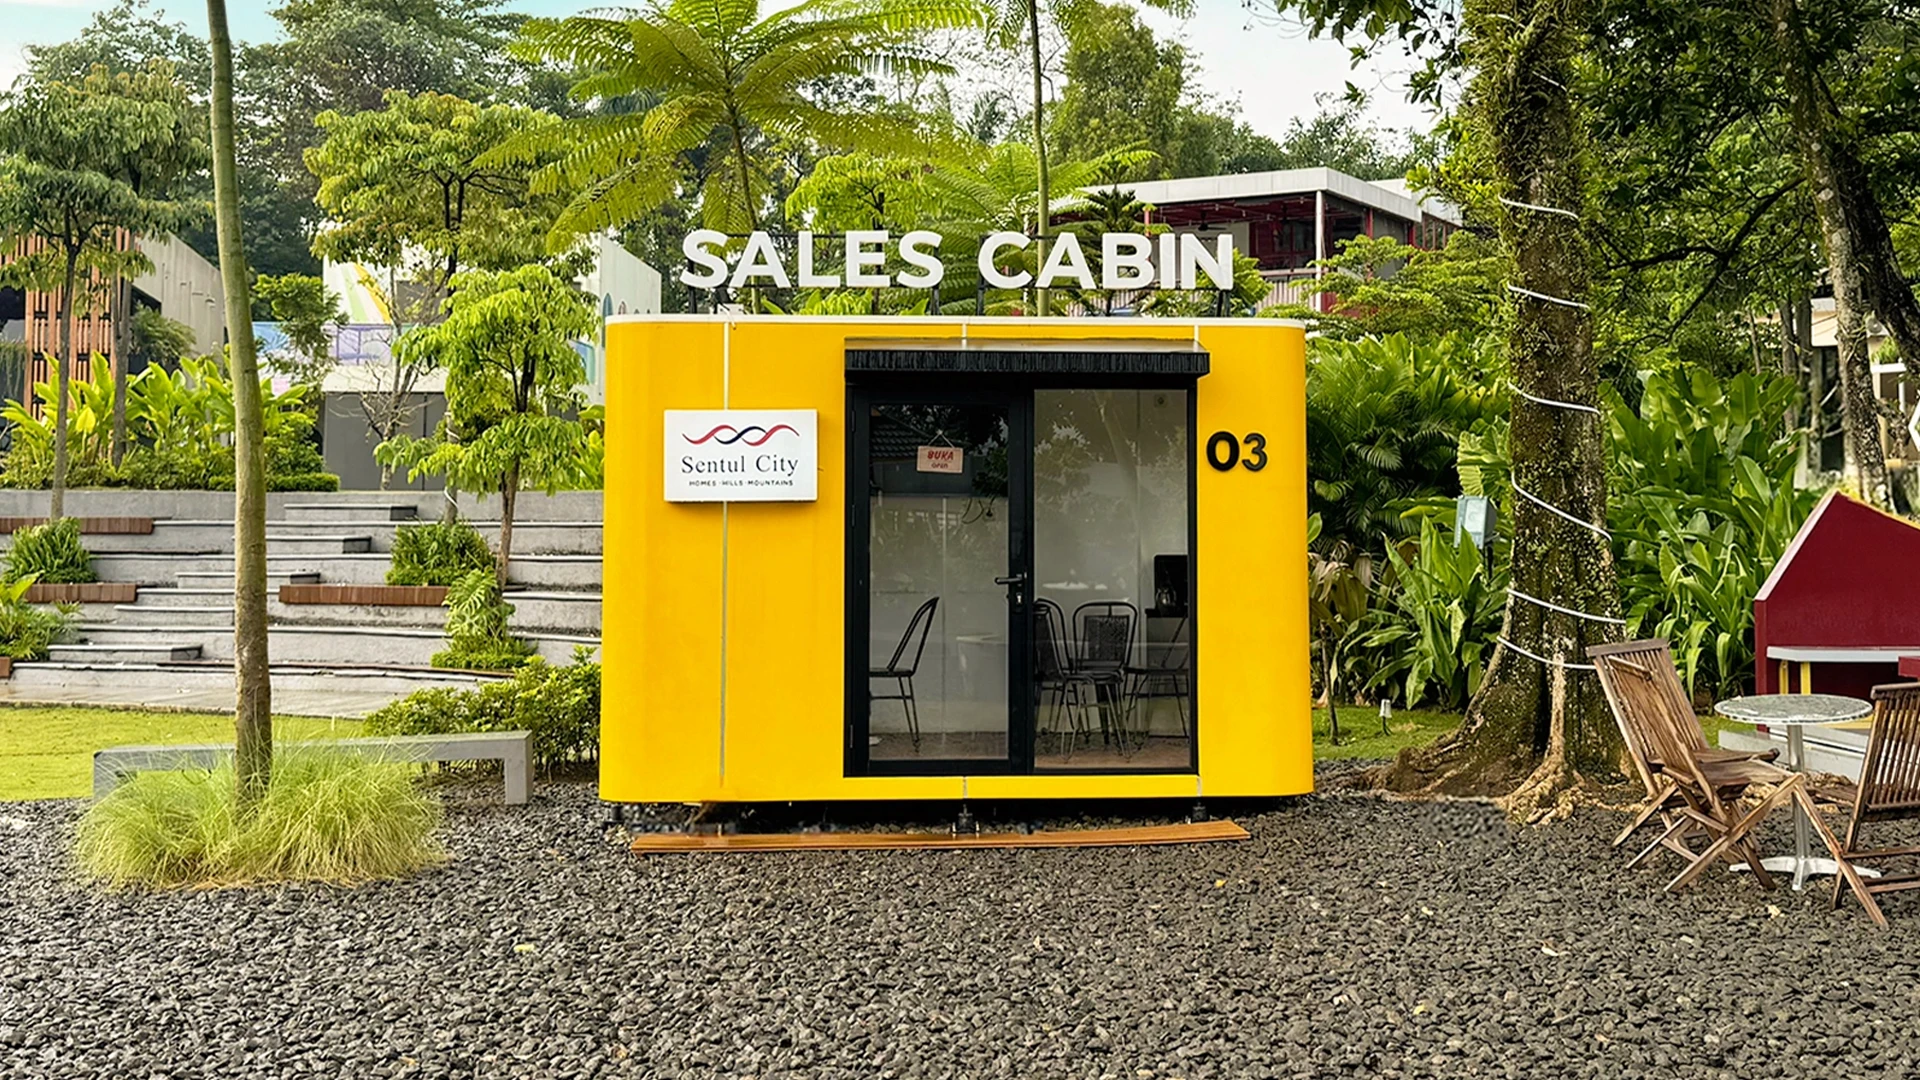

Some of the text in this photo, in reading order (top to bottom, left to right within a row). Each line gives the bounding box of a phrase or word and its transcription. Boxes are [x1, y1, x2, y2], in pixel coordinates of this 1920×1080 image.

[679, 229, 1234, 290] SALES CABIN
[681, 454, 799, 477] Sentul City
[927, 450, 954, 461] BUKA
[1206, 430, 1268, 472] 03
